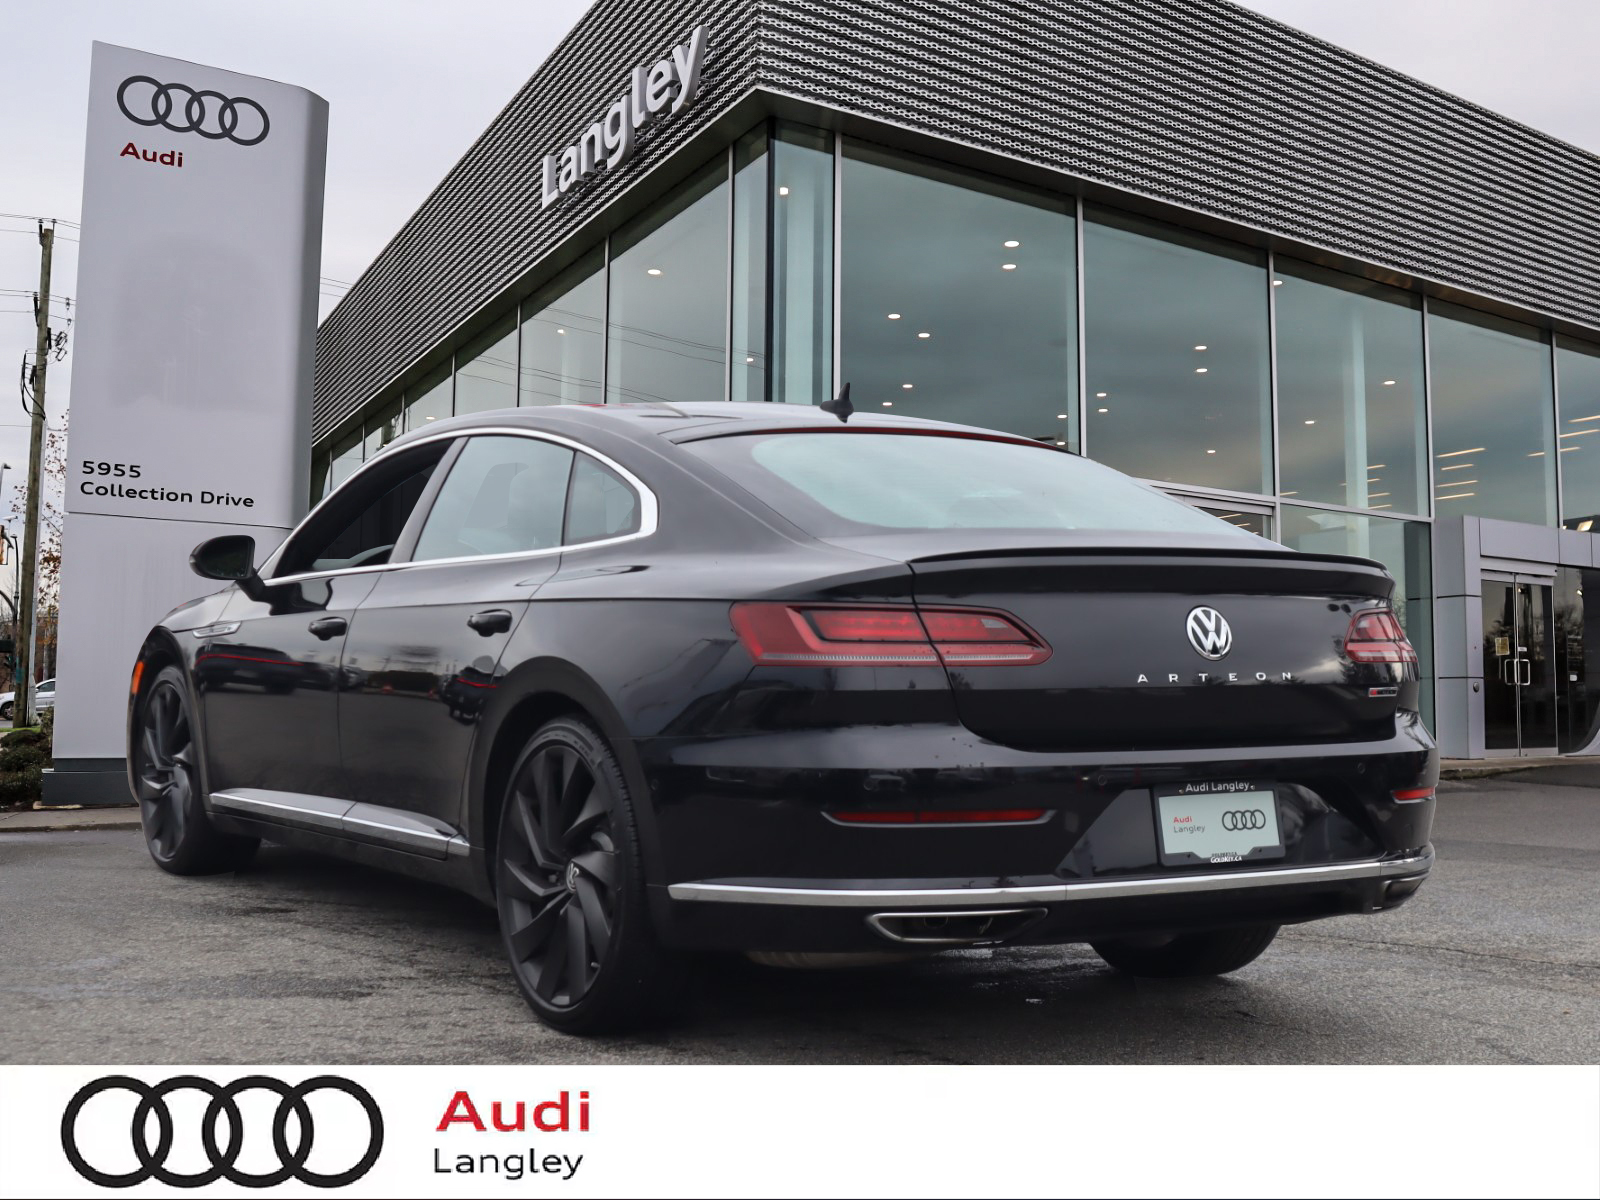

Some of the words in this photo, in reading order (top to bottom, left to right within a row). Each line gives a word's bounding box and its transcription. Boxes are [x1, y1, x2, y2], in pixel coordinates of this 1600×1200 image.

[541, 25, 710, 210] Langley
[120, 142, 183, 167] Audi
[82, 460, 141, 478] 5955
[80, 481, 193, 503] Collection
[200, 491, 254, 507] Drive
[1137, 672, 1293, 683] ARTEON
[1185, 783, 1208, 792] Audi
[1211, 781, 1249, 792] Langley
[1173, 825, 1206, 834] Langley
